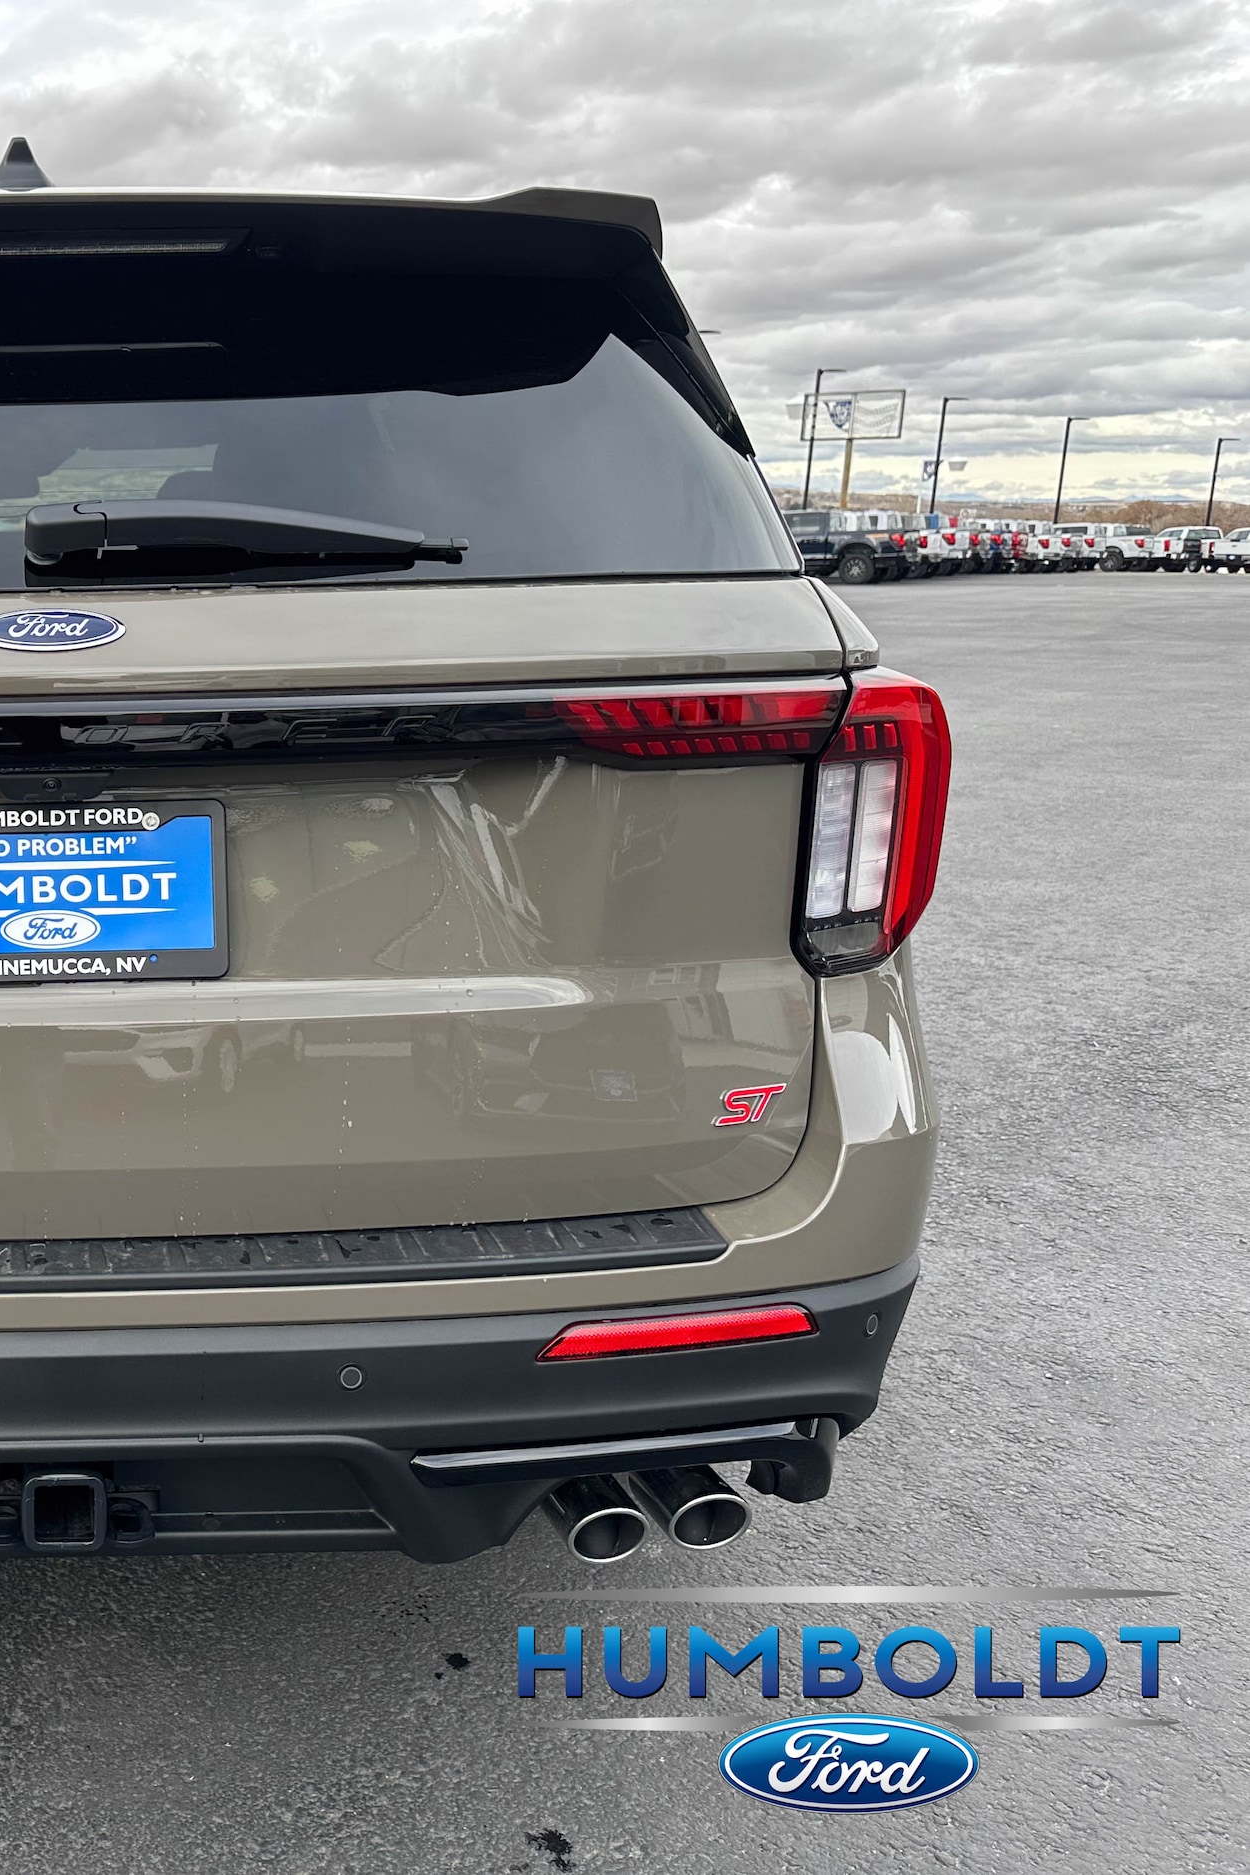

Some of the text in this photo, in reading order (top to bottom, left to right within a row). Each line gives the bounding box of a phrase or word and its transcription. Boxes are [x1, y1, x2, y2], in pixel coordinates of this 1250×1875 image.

[8, 613, 89, 637] Ford
[84, 807, 144, 826] FORD
[23, 916, 78, 941] Ford
[116, 956, 147, 973] NV
[715, 1082, 787, 1127] ST
